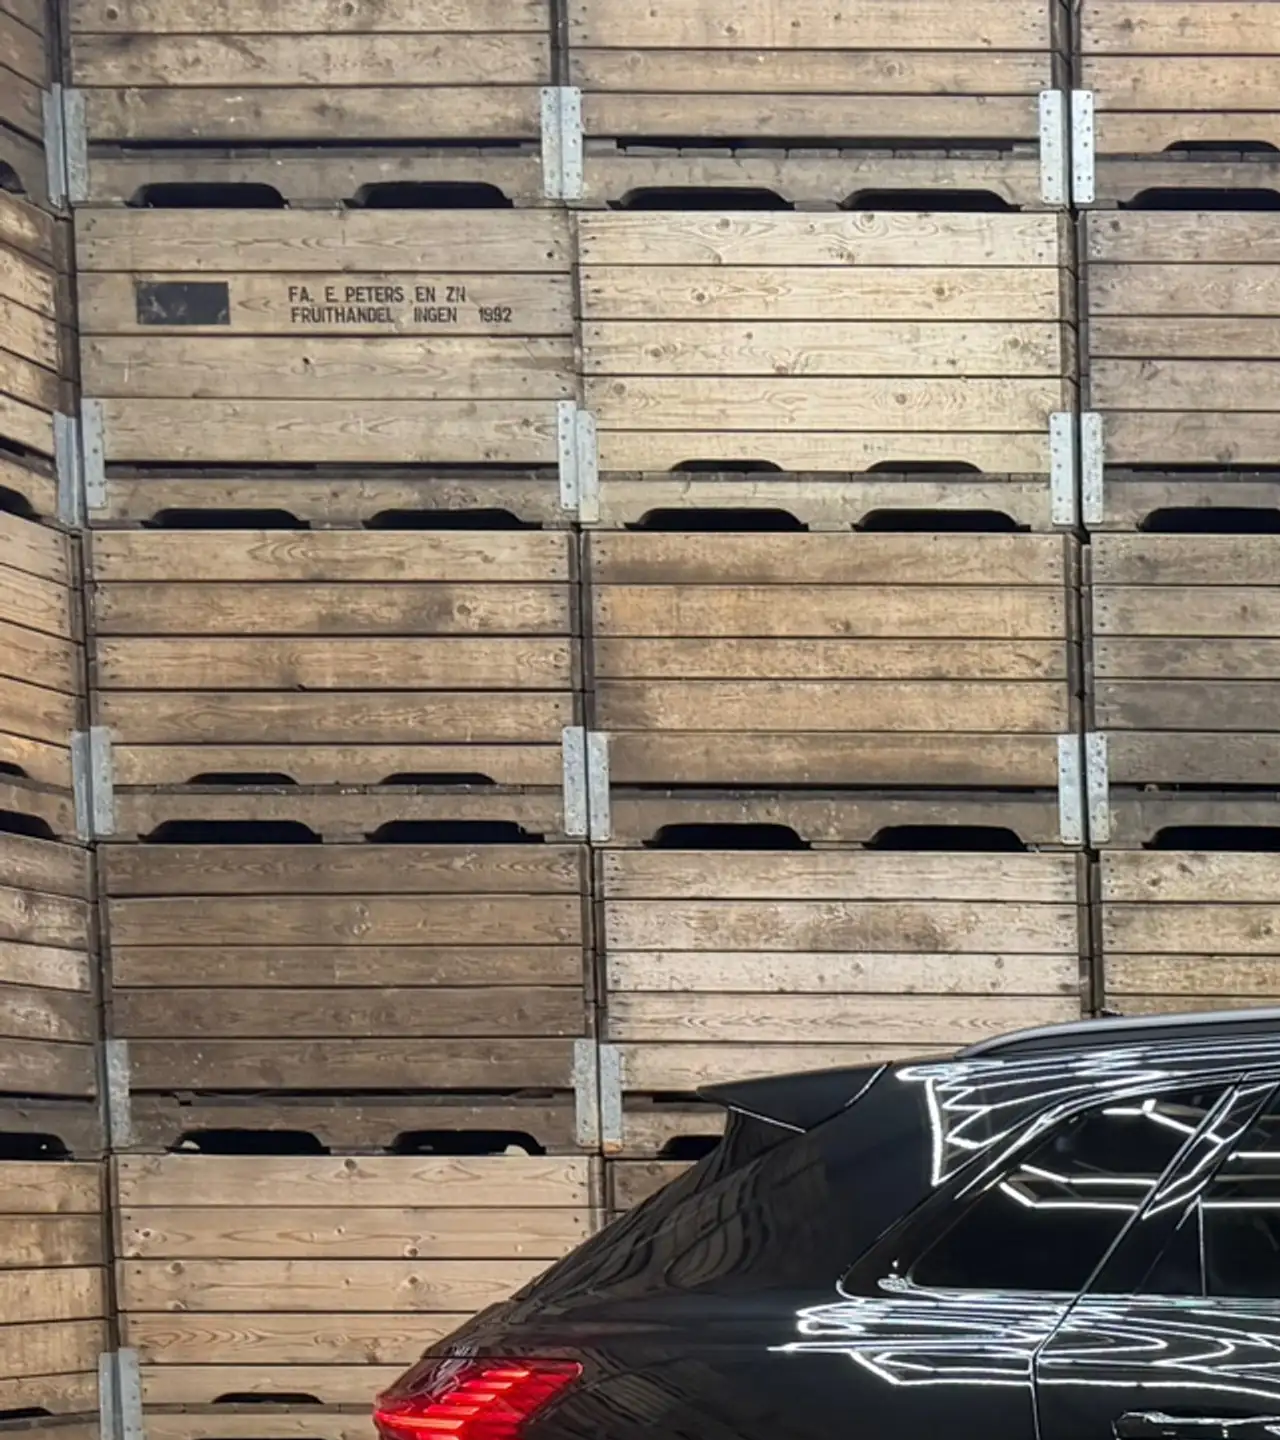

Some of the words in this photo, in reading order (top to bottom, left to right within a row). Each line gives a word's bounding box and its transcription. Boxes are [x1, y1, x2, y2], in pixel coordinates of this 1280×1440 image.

[287, 286, 315, 303] FA.
[345, 286, 404, 303] PETERS
[415, 286, 436, 303] EN
[445, 286, 466, 303] ZN
[291, 306, 395, 323] FRUITHANDEL
[413, 306, 458, 323] INGEN
[478, 306, 513, 323] 1992
